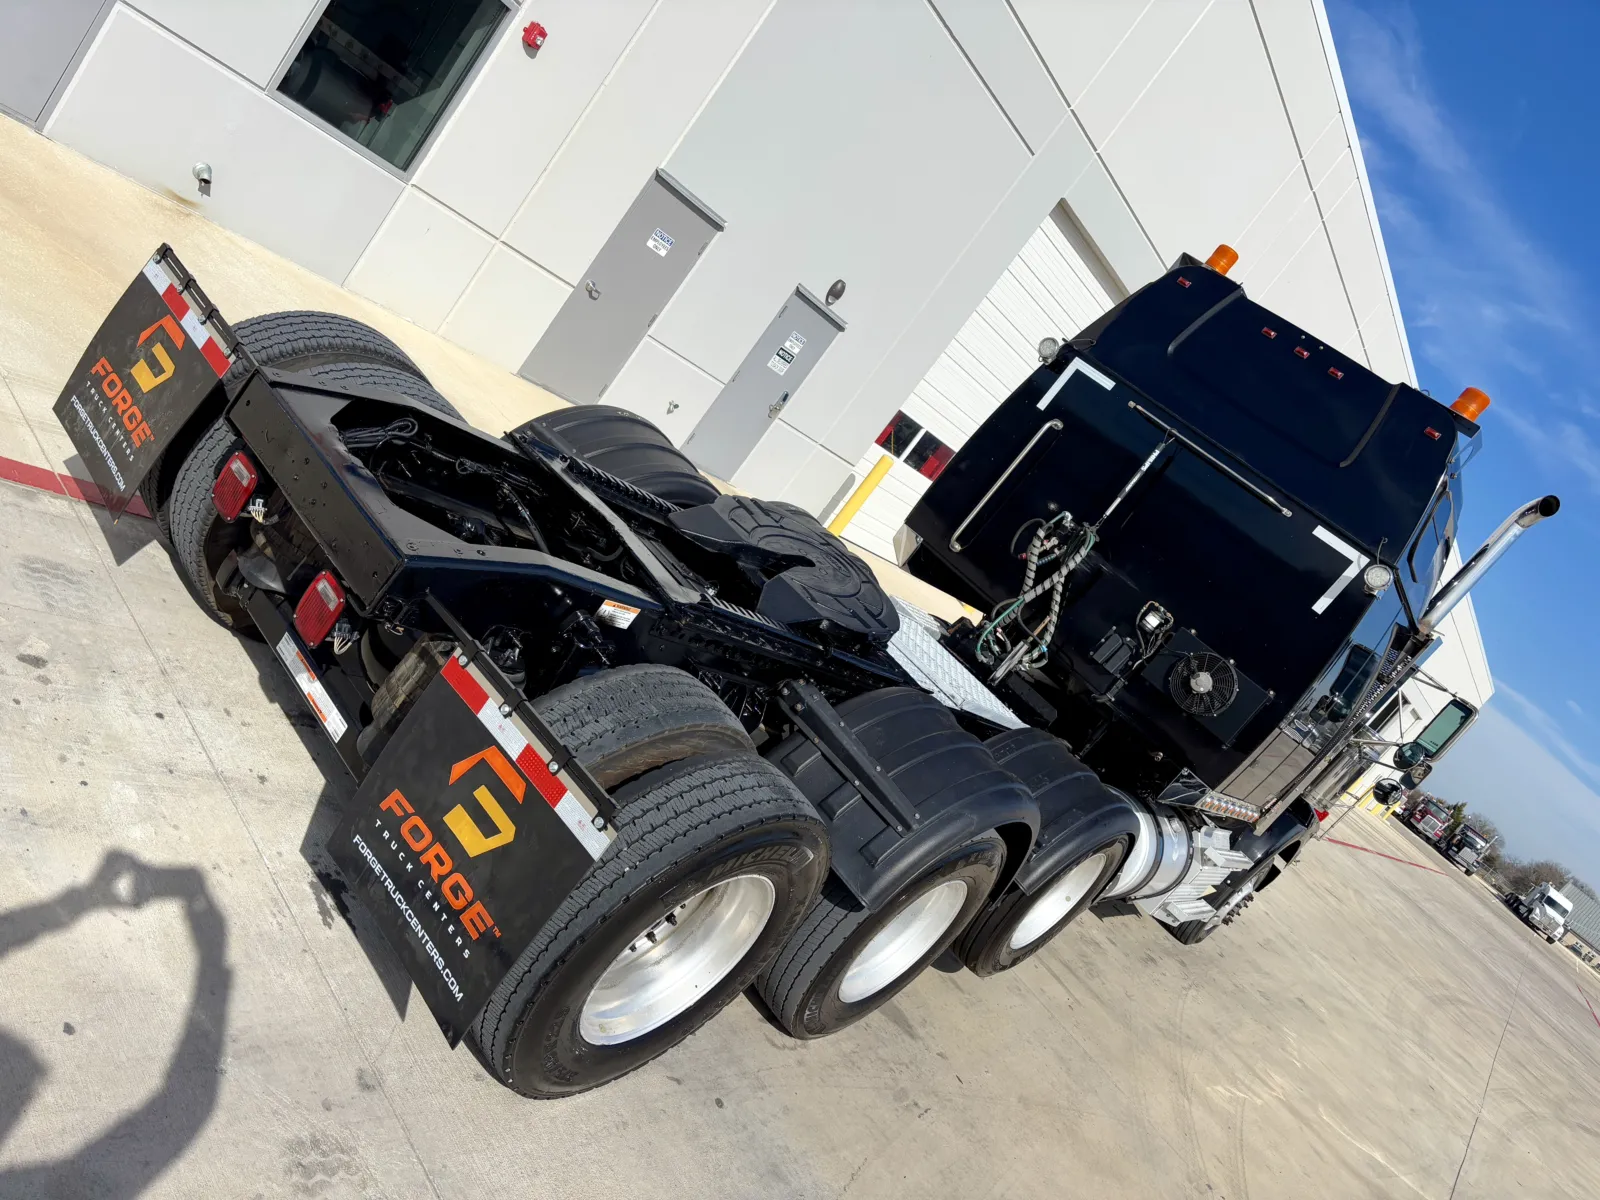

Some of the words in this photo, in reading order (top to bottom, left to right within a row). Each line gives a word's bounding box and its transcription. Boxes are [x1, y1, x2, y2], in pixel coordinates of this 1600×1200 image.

[70, 395, 126, 492] FORGETRUCKCENTERS.COM
[86, 380, 107, 414] TRUCK
[108, 416, 134, 462] CENTERS
[91, 357, 153, 448] FORGE
[352, 834, 464, 1002] FORGETRUCKCENTERS.COM
[374, 818, 413, 872] TRUCK
[417, 879, 470, 959] CENTERS
[379, 788, 494, 941] FORGE
